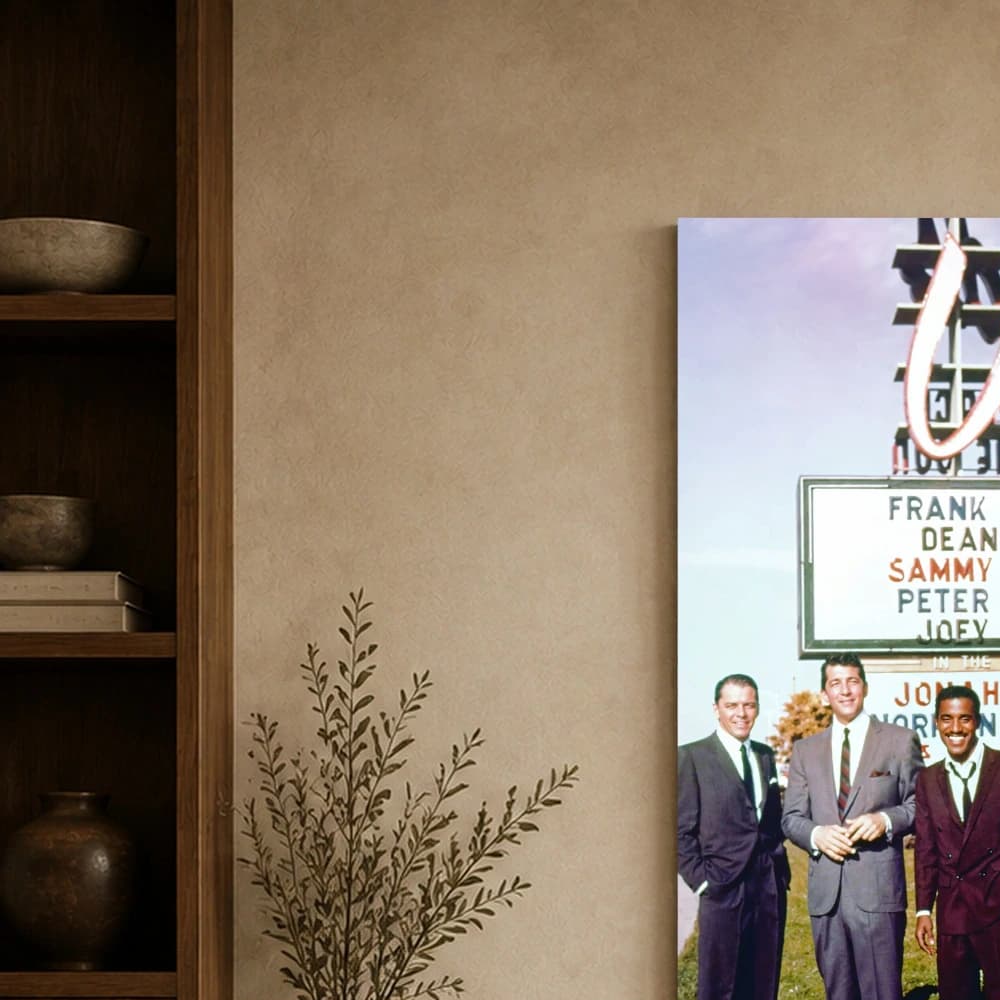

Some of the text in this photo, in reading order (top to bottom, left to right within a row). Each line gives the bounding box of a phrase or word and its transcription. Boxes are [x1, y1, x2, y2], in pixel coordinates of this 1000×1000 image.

[888, 496, 987, 521] FRANK
[921, 526, 998, 552] DEAN
[888, 557, 993, 583] SAMMY
[898, 588, 989, 613] PETER
[916, 618, 988, 645] JOEY
[932, 655, 950, 669] IN
[961, 655, 991, 668] THE
[894, 681, 999, 707] JOH
